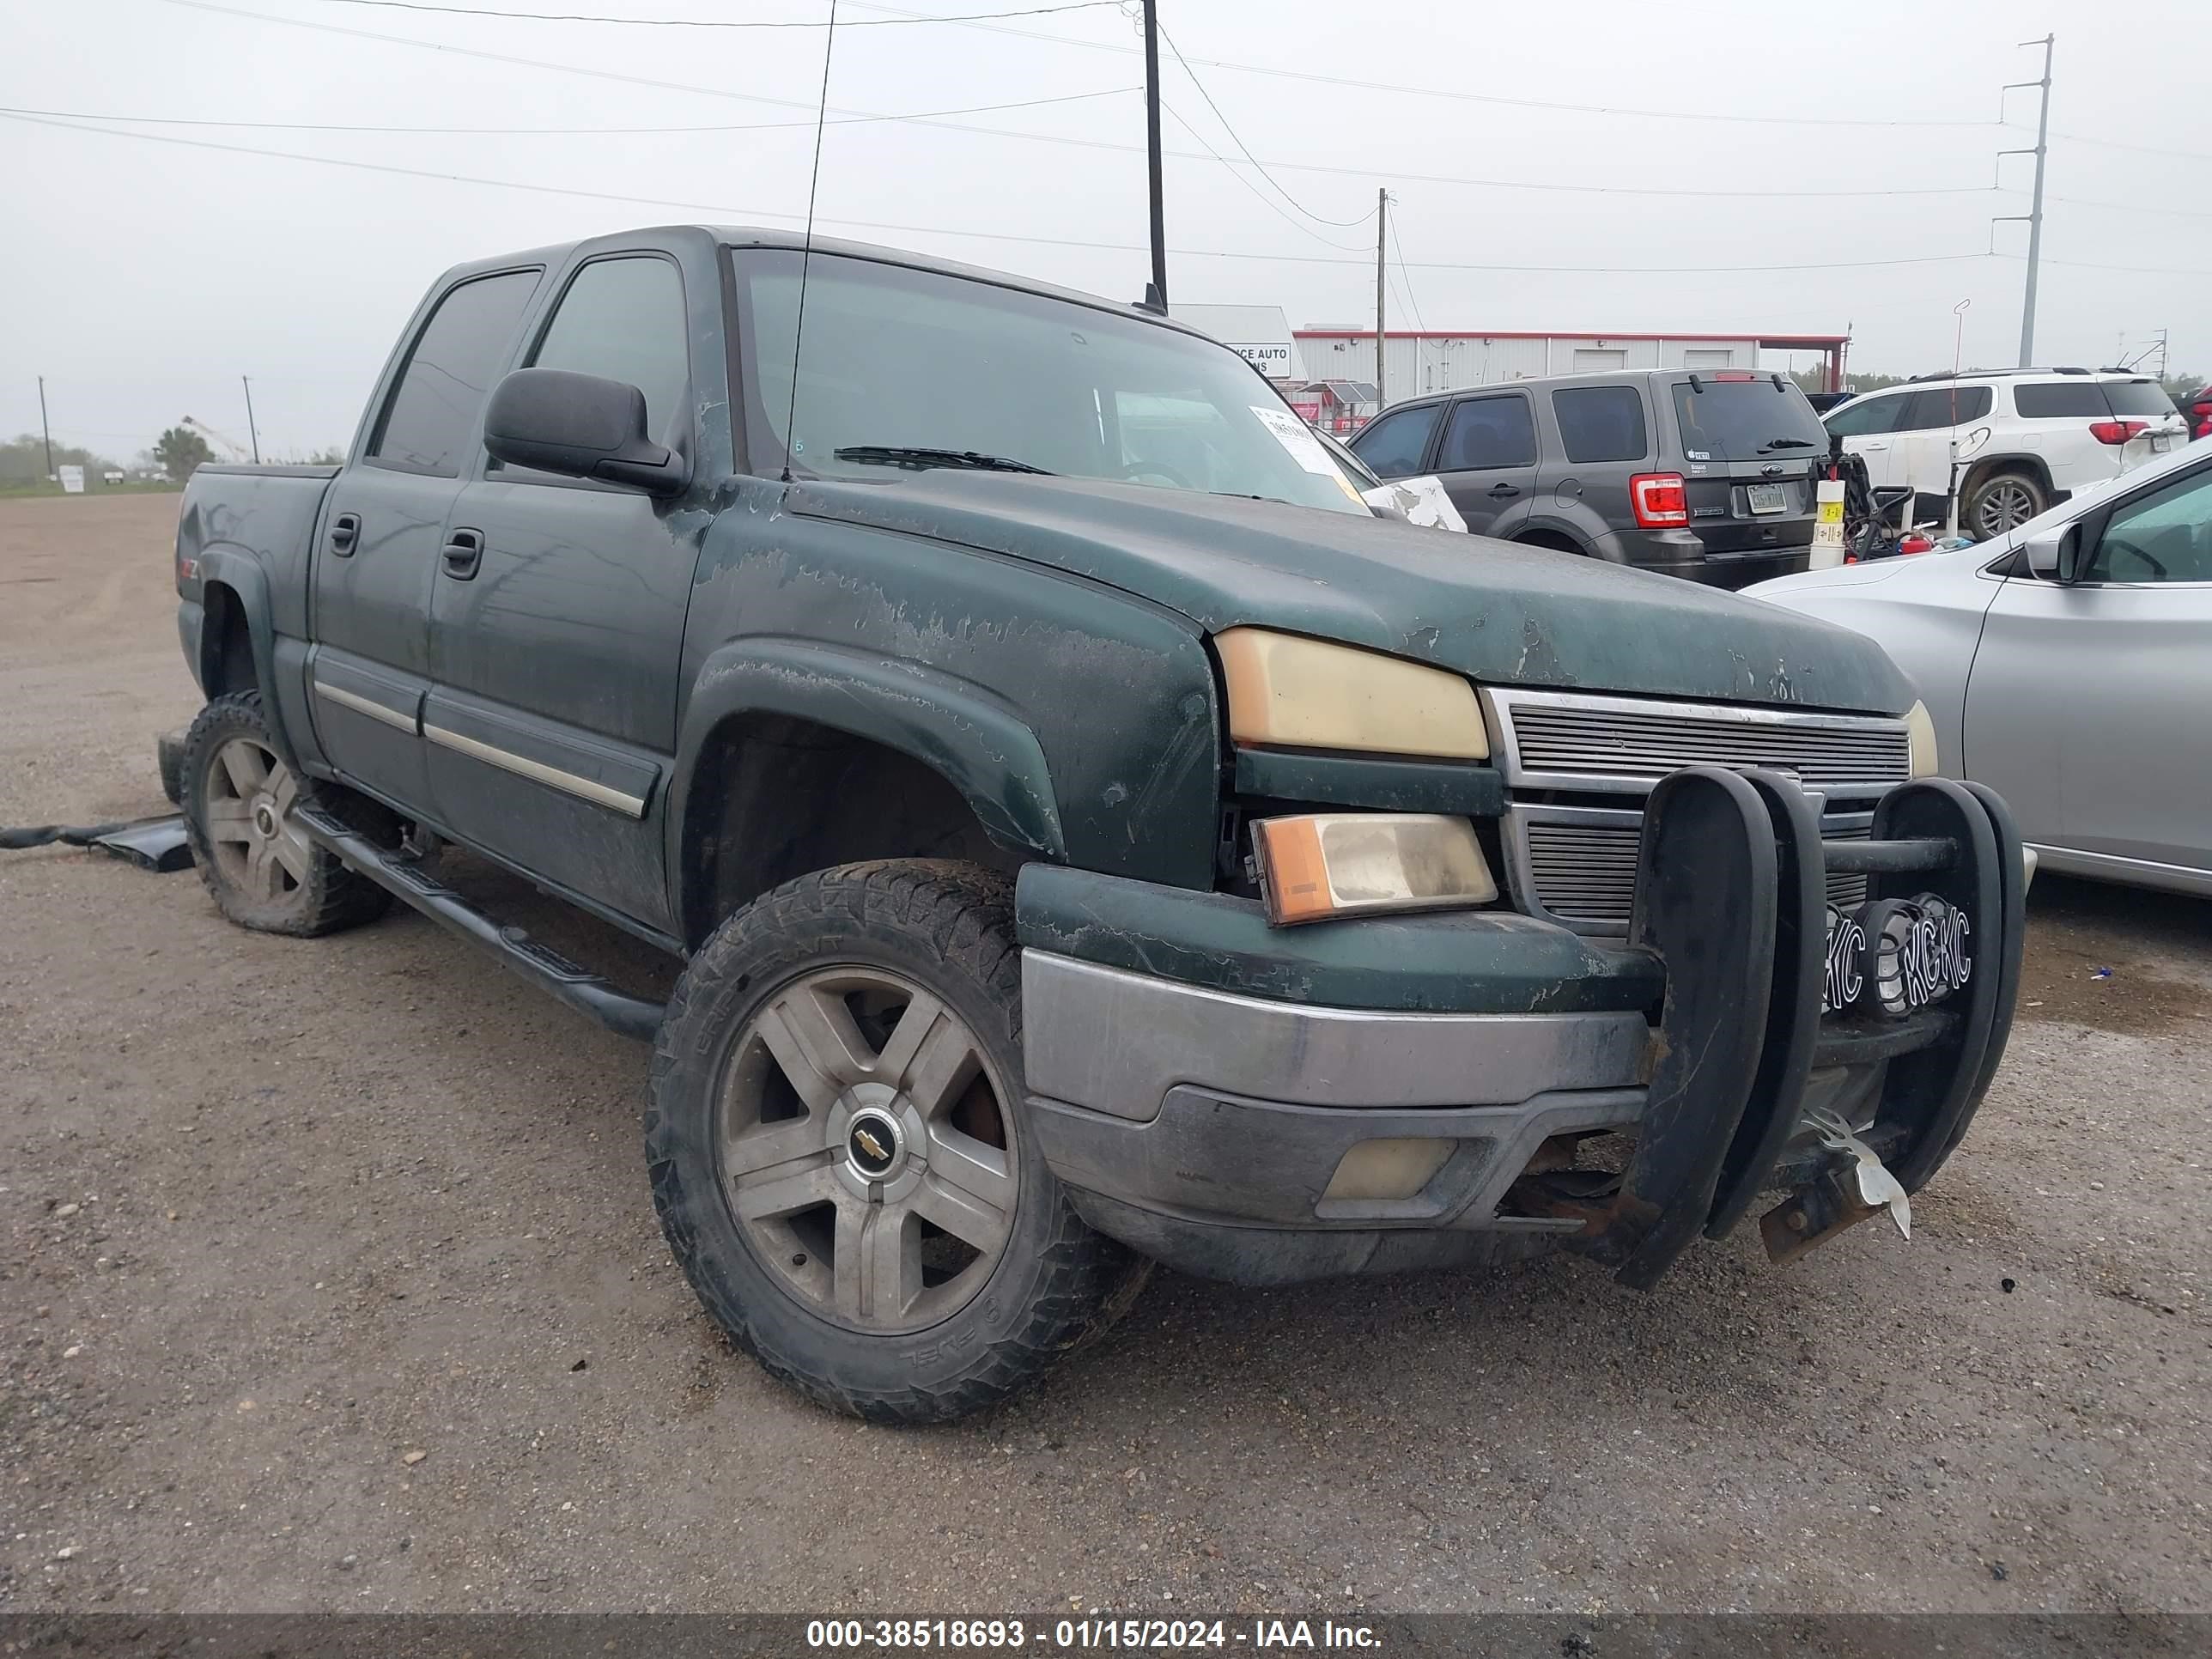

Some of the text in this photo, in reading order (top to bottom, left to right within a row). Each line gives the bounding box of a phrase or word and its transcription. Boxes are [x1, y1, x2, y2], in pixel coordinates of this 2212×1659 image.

[1257, 349, 1287, 359] AUTO
[1823, 918, 1866, 1010] KC
[1903, 920, 1941, 1007] KC
[1939, 906, 1972, 990] KC
